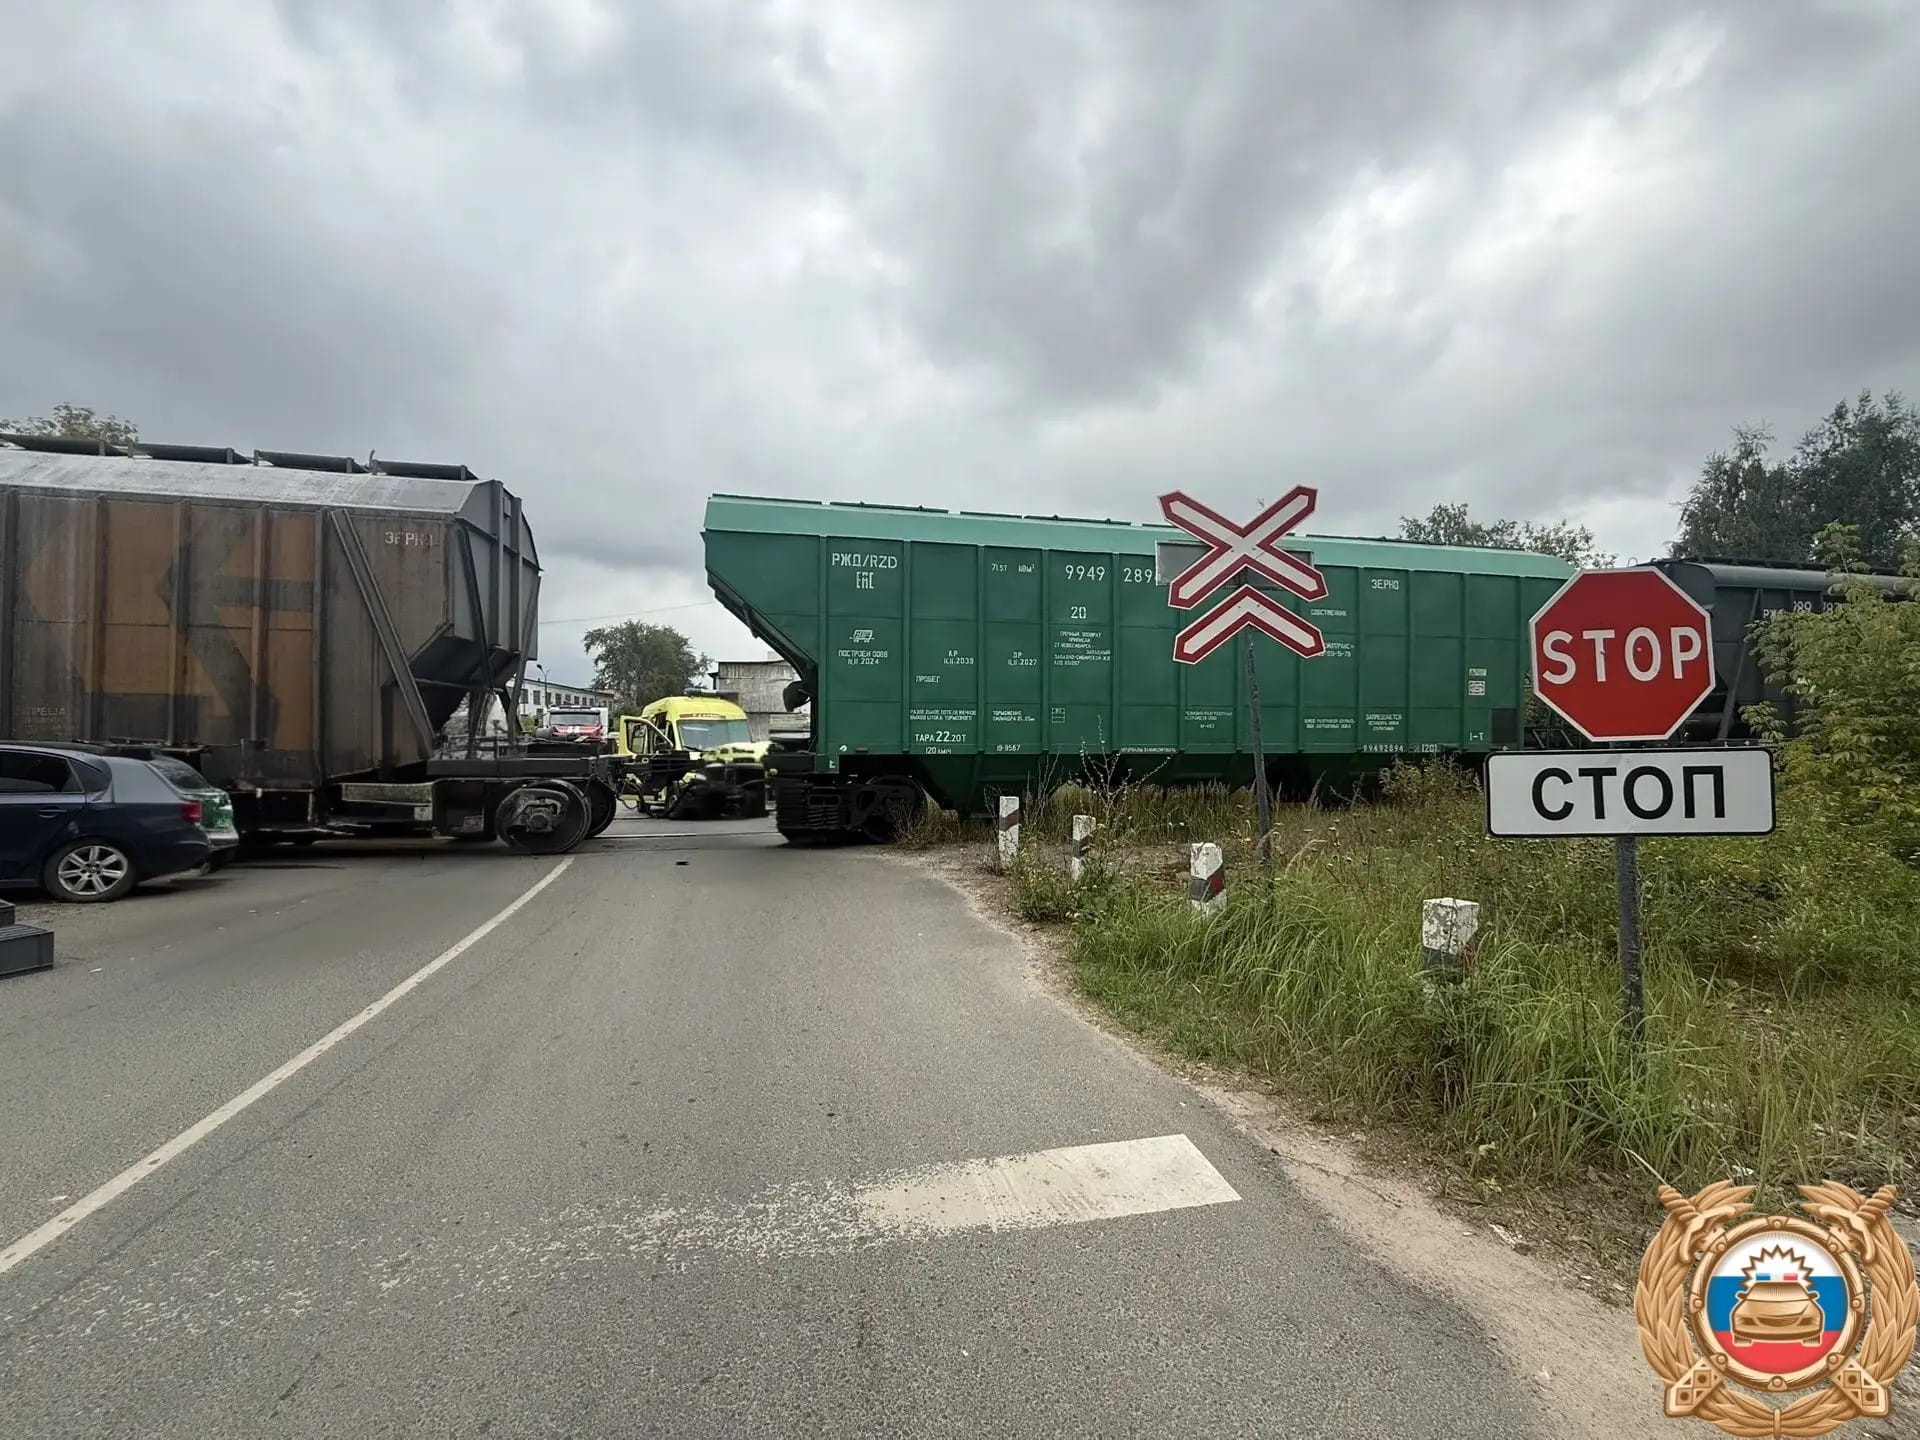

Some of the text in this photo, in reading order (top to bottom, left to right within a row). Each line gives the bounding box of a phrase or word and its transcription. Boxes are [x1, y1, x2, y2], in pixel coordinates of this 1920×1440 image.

[831, 552, 898, 569] РЖД/RZD
[1065, 564, 1154, 583] 9949 289
[1371, 578, 1400, 590] ЗЕРНО
[1071, 606, 1087, 619] 20
[1541, 626, 1702, 685] STOP
[915, 733, 935, 742] ТАРА
[1531, 765, 1726, 821] СТОП
